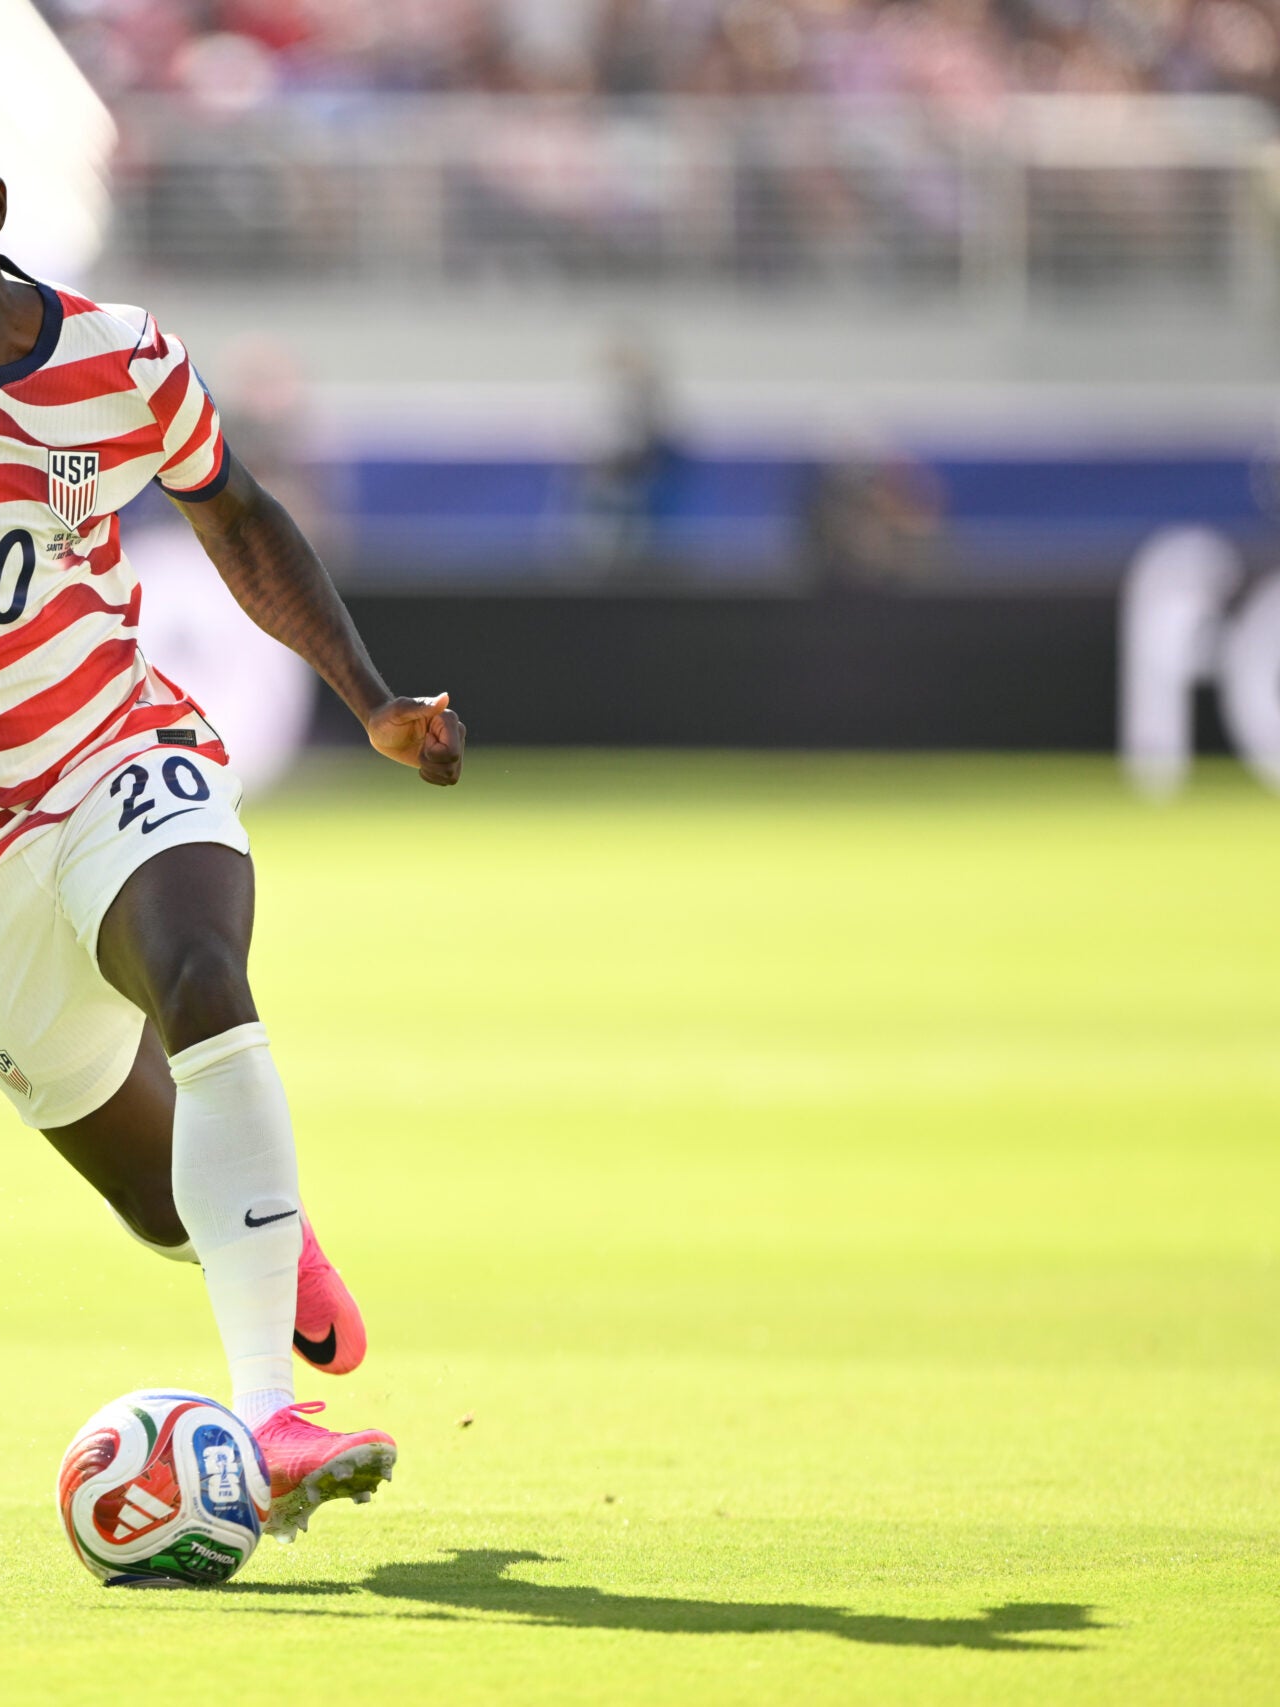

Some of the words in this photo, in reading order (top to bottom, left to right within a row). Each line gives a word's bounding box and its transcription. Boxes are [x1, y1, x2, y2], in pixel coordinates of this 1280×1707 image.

[52, 455, 96, 485] USA
[110, 756, 210, 831] 20
[191, 1540, 236, 1565] TRIONDA
